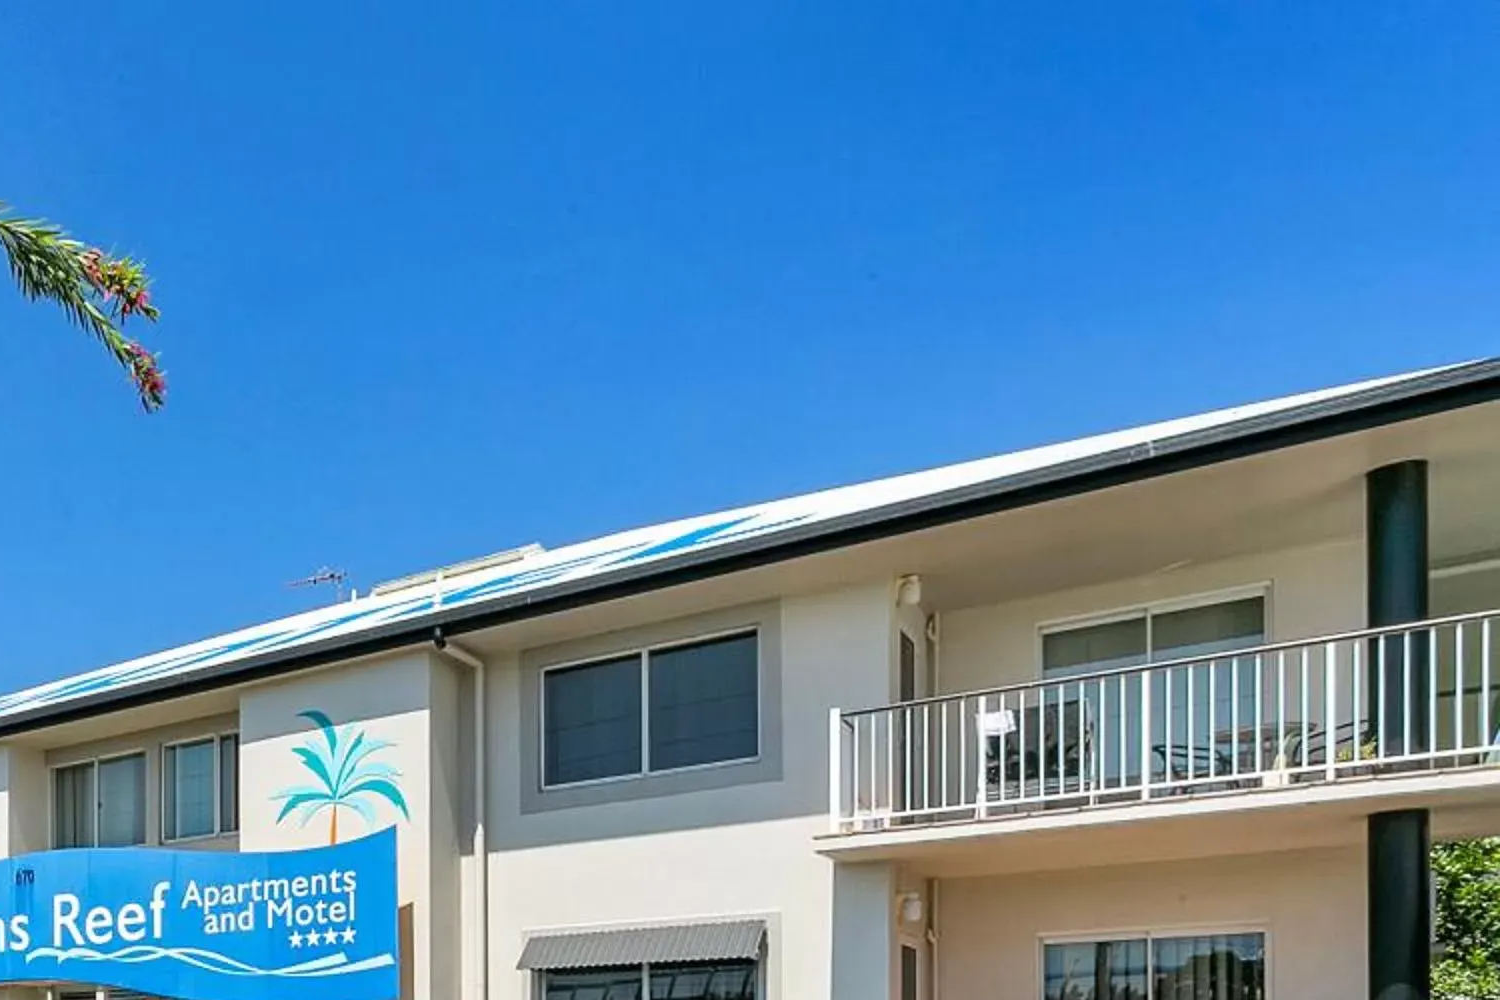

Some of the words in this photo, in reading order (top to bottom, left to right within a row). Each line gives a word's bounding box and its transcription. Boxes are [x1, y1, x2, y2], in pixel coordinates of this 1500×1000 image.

[15, 869, 35, 886] 670
[181, 868, 357, 914] Apartments
[53, 881, 171, 947] Reef
[204, 902, 254, 935] and
[267, 891, 355, 929] Motel
